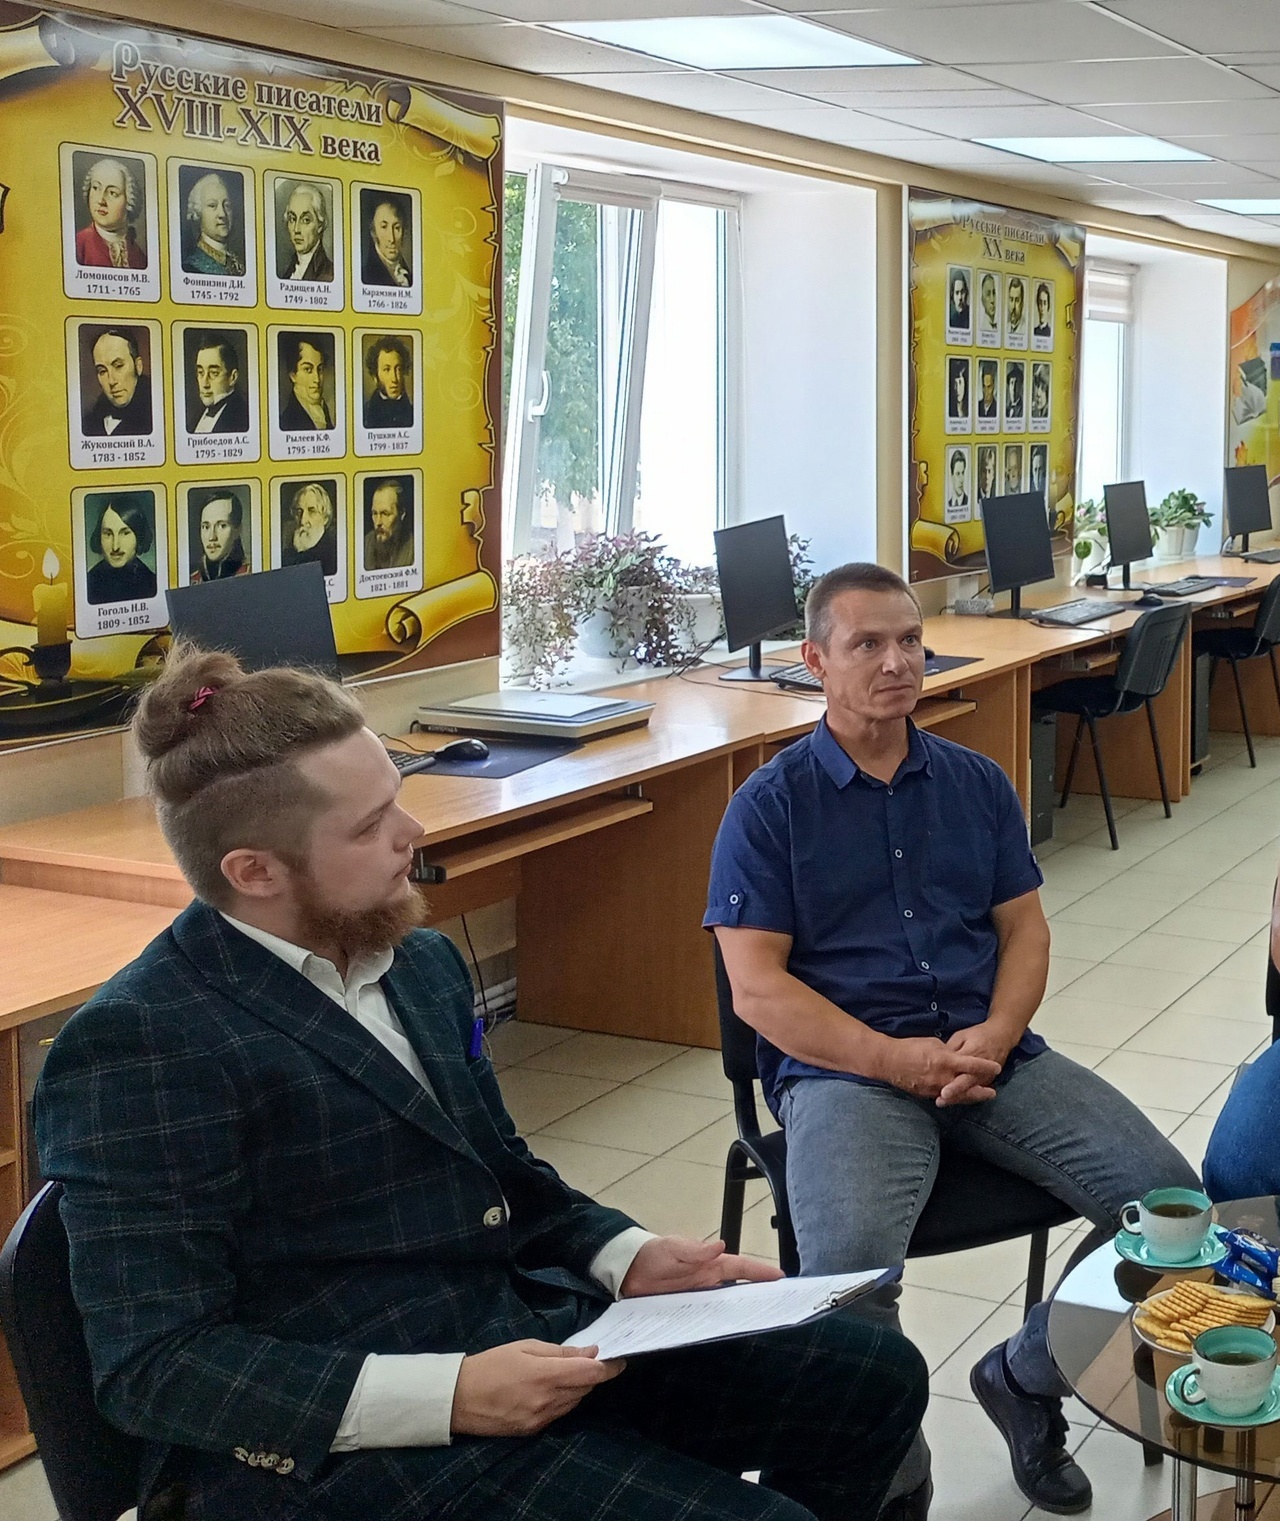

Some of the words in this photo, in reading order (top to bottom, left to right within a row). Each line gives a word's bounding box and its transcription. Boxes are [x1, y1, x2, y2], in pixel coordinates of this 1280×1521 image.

[112, 40, 247, 99] Русские
[256, 82, 383, 125] писатели
[321, 134, 381, 164] века
[962, 215, 1001, 238] Русские
[1004, 226, 1044, 244] писатели
[1005, 249, 1025, 262] века
[75, 269, 129, 282] Ломоносов
[131, 271, 150, 283] М.В.
[183, 276, 227, 288] Фонвизин
[228, 279, 246, 290] Д.И.
[280, 283, 315, 293] Радищев
[87, 284, 110, 294] 1711
[118, 286, 141, 296] 1765
[191, 290, 212, 299] 1745
[219, 292, 239, 301] 1792
[284, 295, 303, 304] 1749
[310, 296, 328, 305] 1802
[368, 300, 385, 308] 1766
[391, 300, 408, 309] 1826
[187, 437, 233, 447] Грибоедов
[234, 436, 250, 445] А.С.
[285, 434, 315, 443] Рылеев
[316, 433, 331, 442] К.Ф.
[367, 432, 396, 441] Пушкин
[81, 439, 135, 451] Жуковский
[137, 438, 155, 448] В.А.
[287, 446, 306, 455] 1795
[312, 445, 331, 454] 1826
[369, 443, 387, 451] 1799
[92, 453, 115, 463] 1783
[124, 452, 146, 461] 1852
[195, 449, 216, 459] 1795
[223, 448, 243, 457] 1829
[359, 570, 403, 583] Достоевский
[370, 582, 387, 592] 1821
[393, 581, 409, 590] 1881
[98, 606, 130, 617] Гоголь
[131, 602, 149, 613] Н.В.
[97, 620, 120, 630] 1809
[128, 614, 150, 626] 1852
